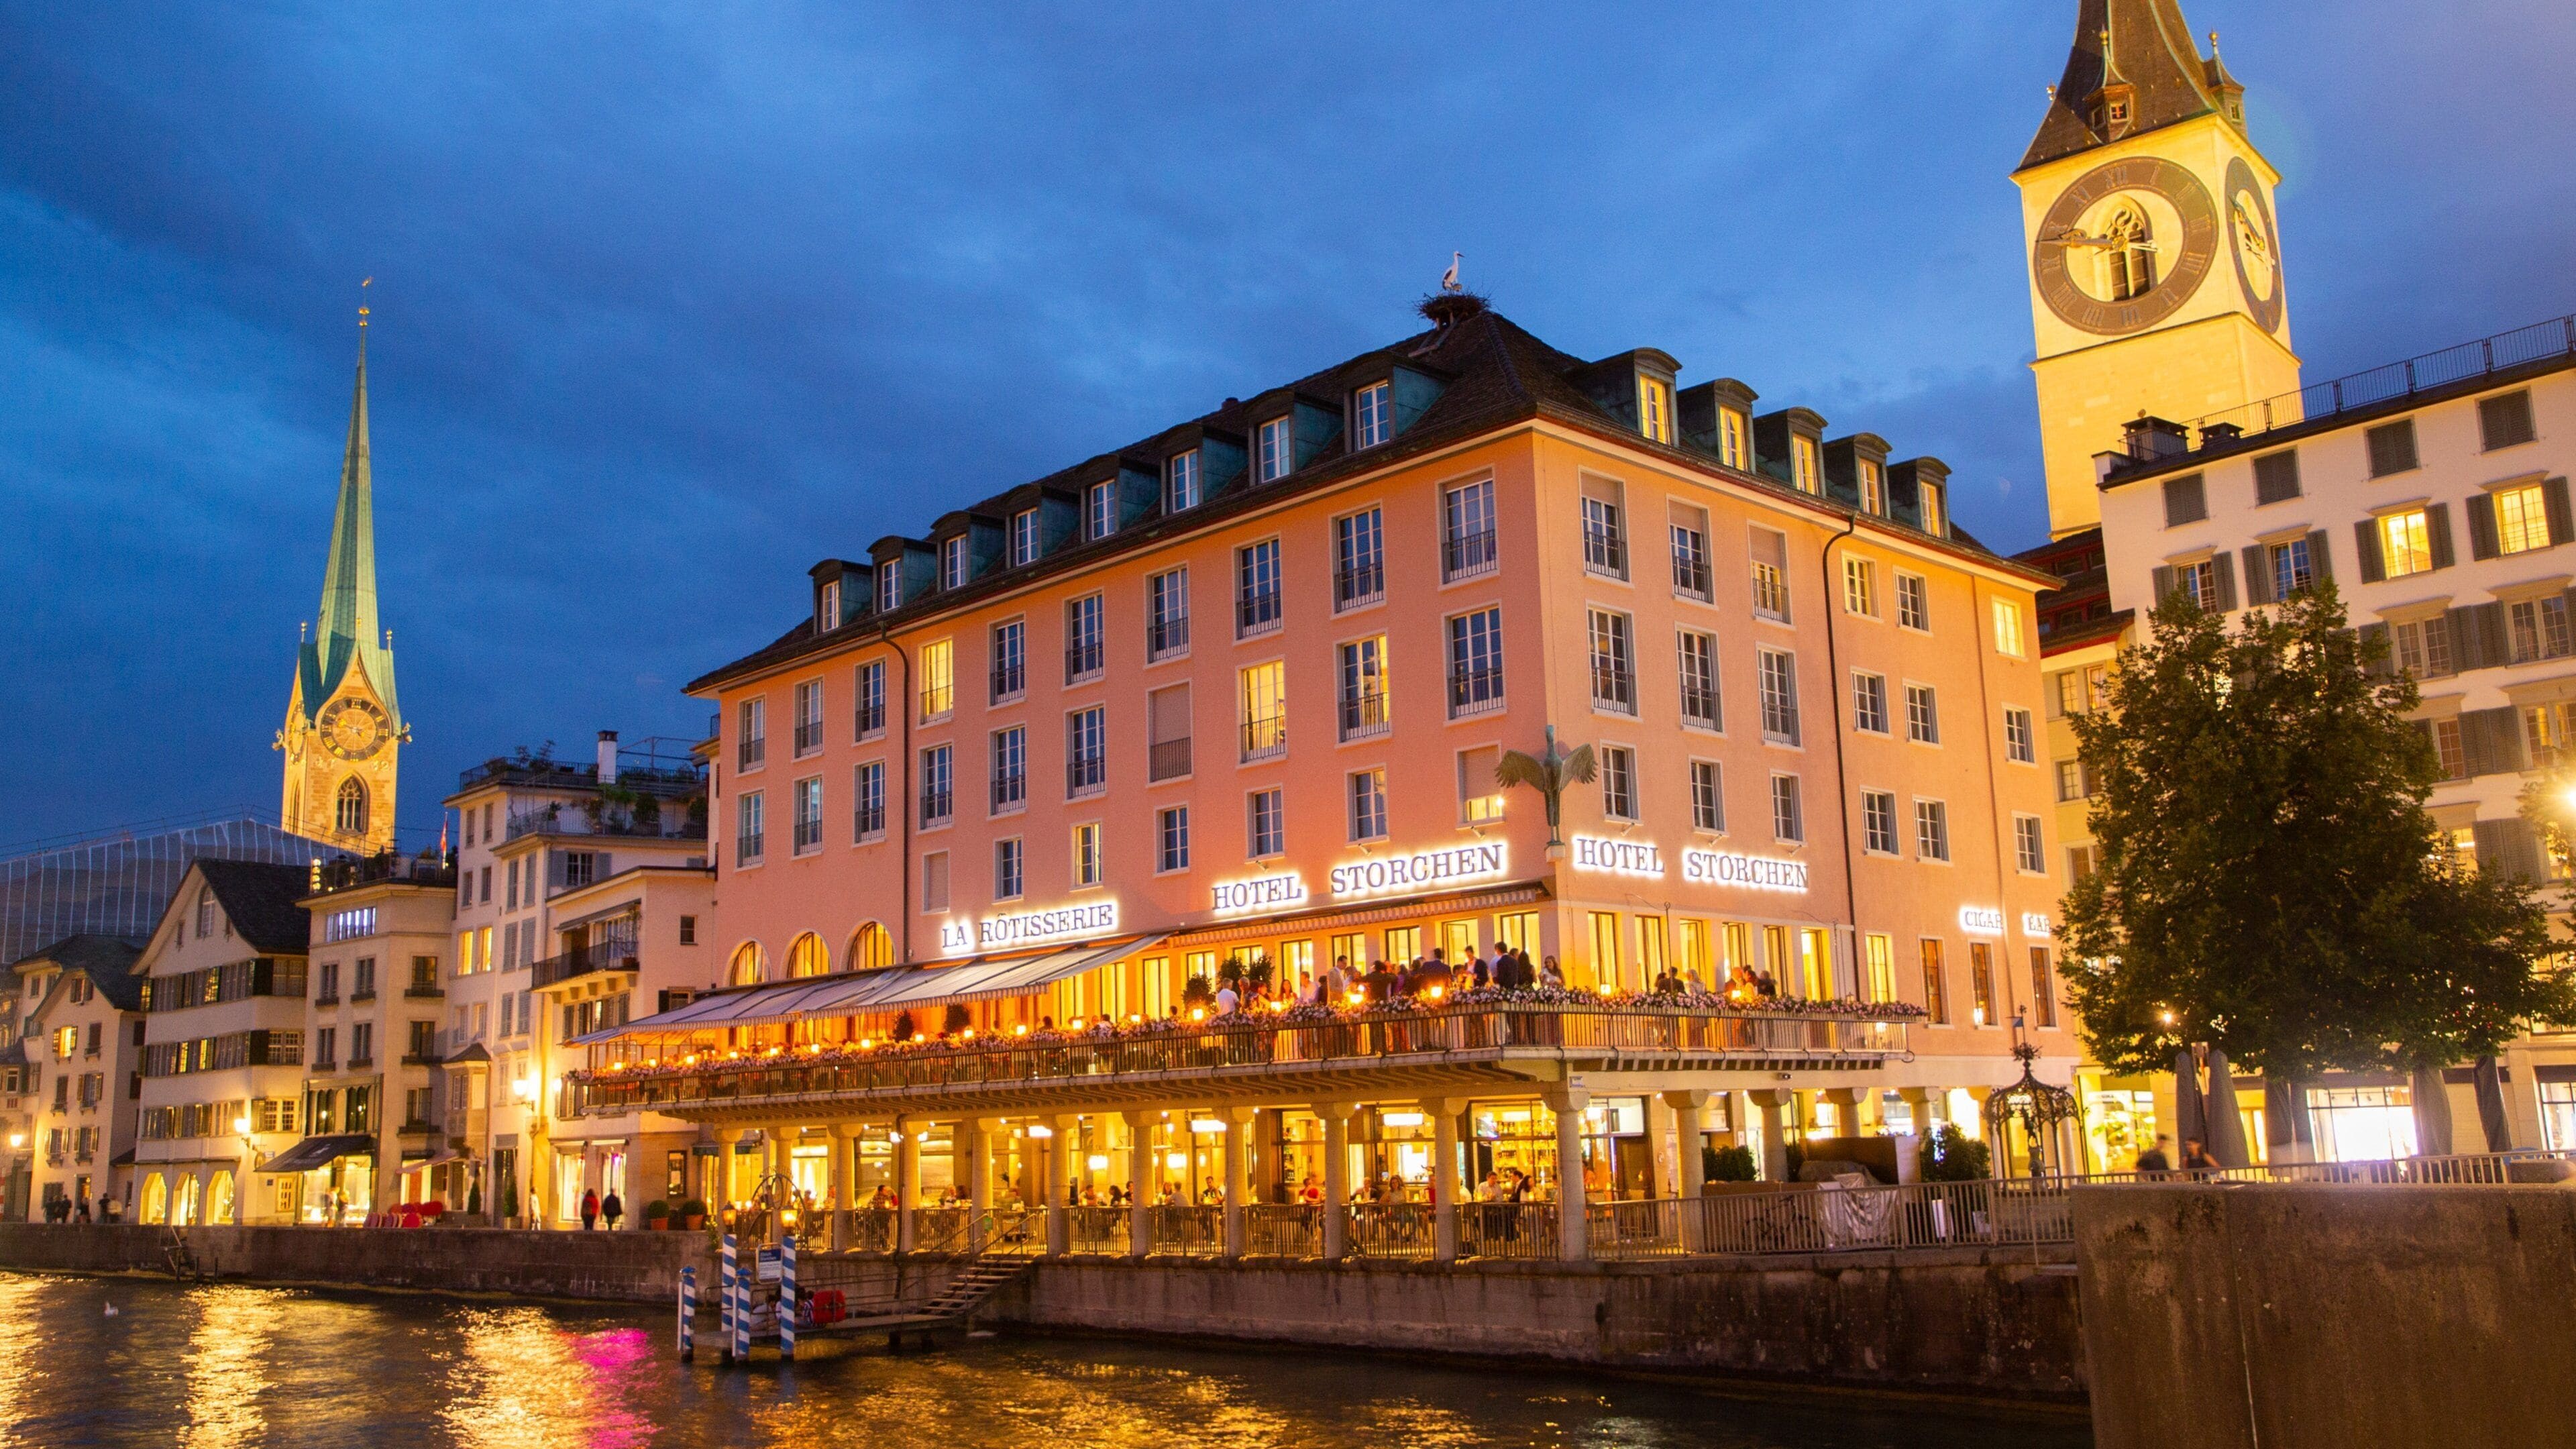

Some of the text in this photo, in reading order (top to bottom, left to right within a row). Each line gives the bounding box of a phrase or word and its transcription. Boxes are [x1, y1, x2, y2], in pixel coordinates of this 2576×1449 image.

[1212, 844, 1503, 911] HOTEL STORCHEN
[1576, 838, 1809, 888] HOTEL STORCHEN
[942, 904, 1113, 948] LA RÔTISSERIE
[1965, 910, 2003, 930] CIGAR
